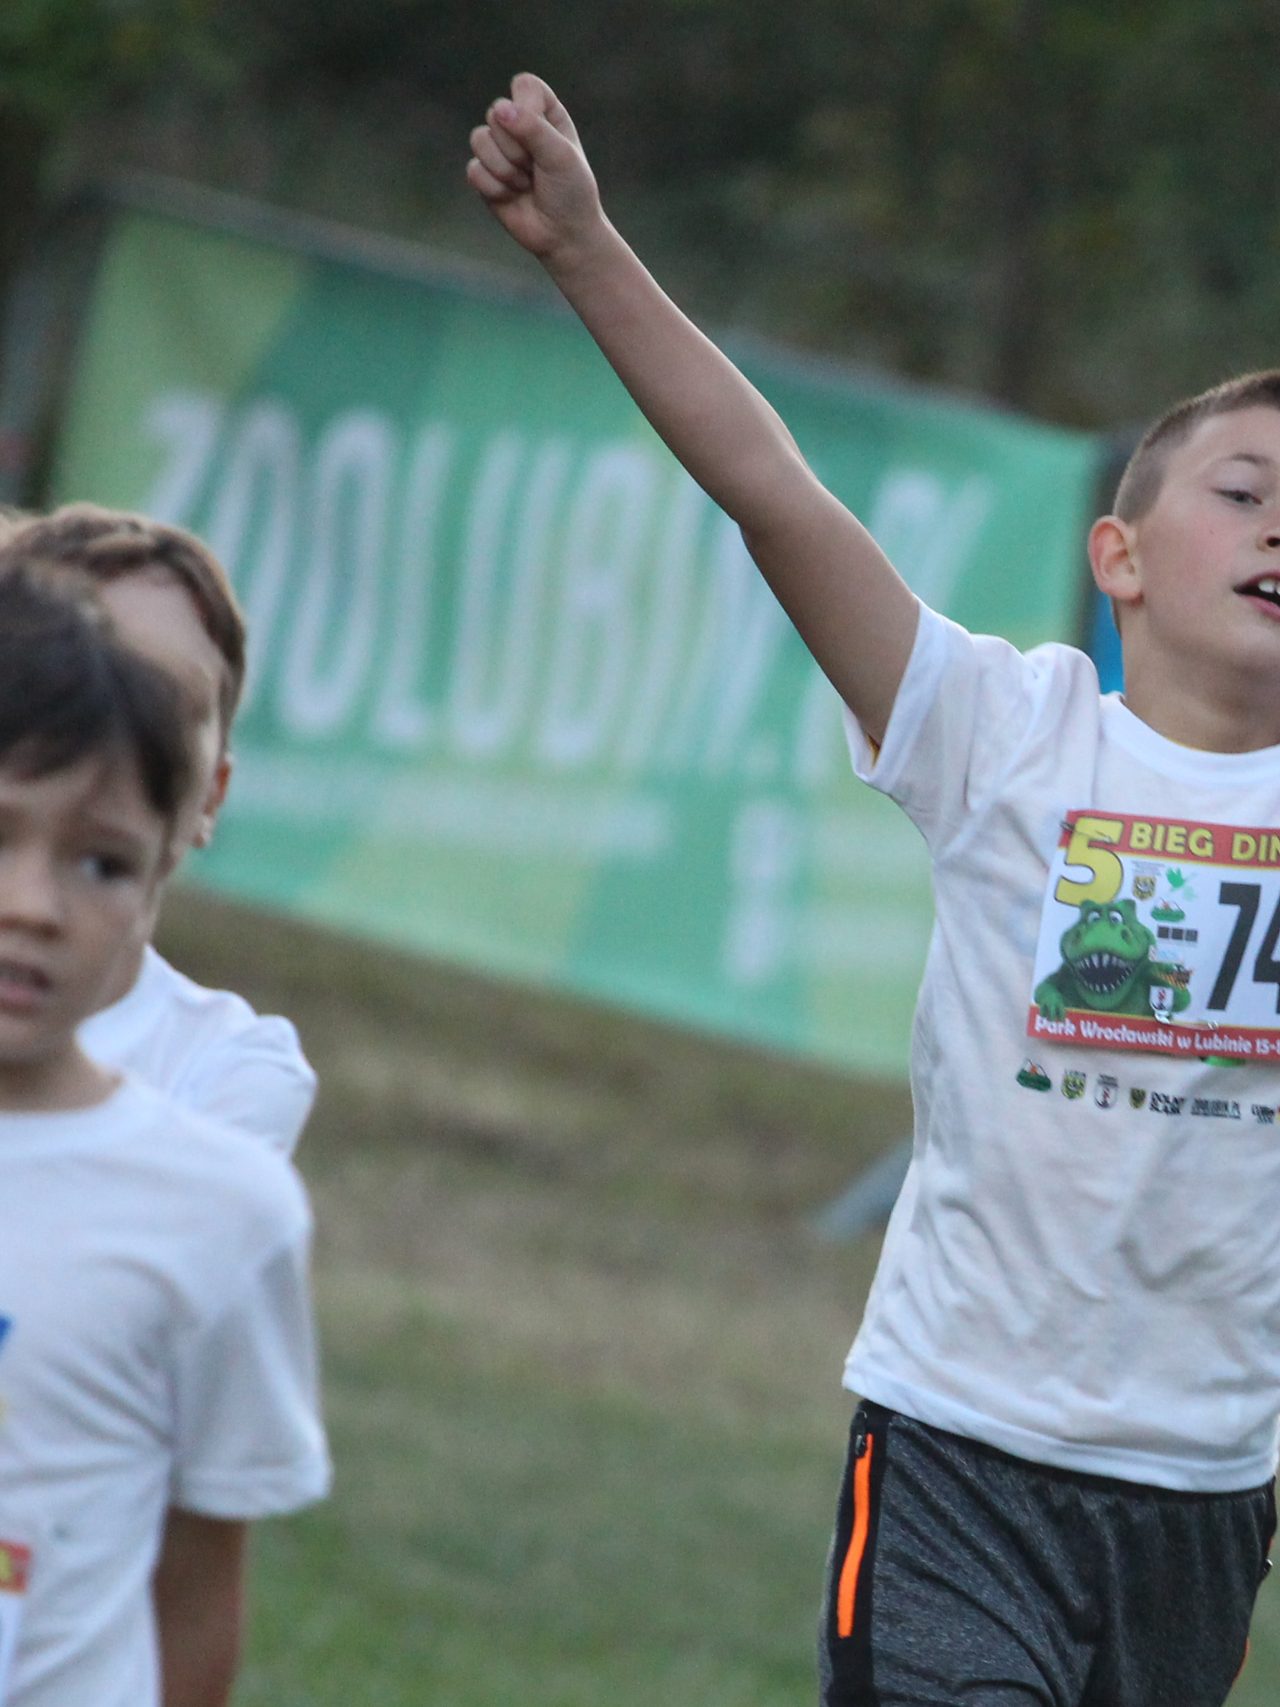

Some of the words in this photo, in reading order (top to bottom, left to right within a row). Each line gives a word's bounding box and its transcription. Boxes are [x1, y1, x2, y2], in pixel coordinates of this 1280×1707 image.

[1054, 816, 1125, 907] 5
[1129, 821, 1215, 858] BIEG
[1034, 1013, 1076, 1037] Park
[1176, 1033, 1192, 1050] w
[1195, 1031, 1252, 1054] Lubinie
